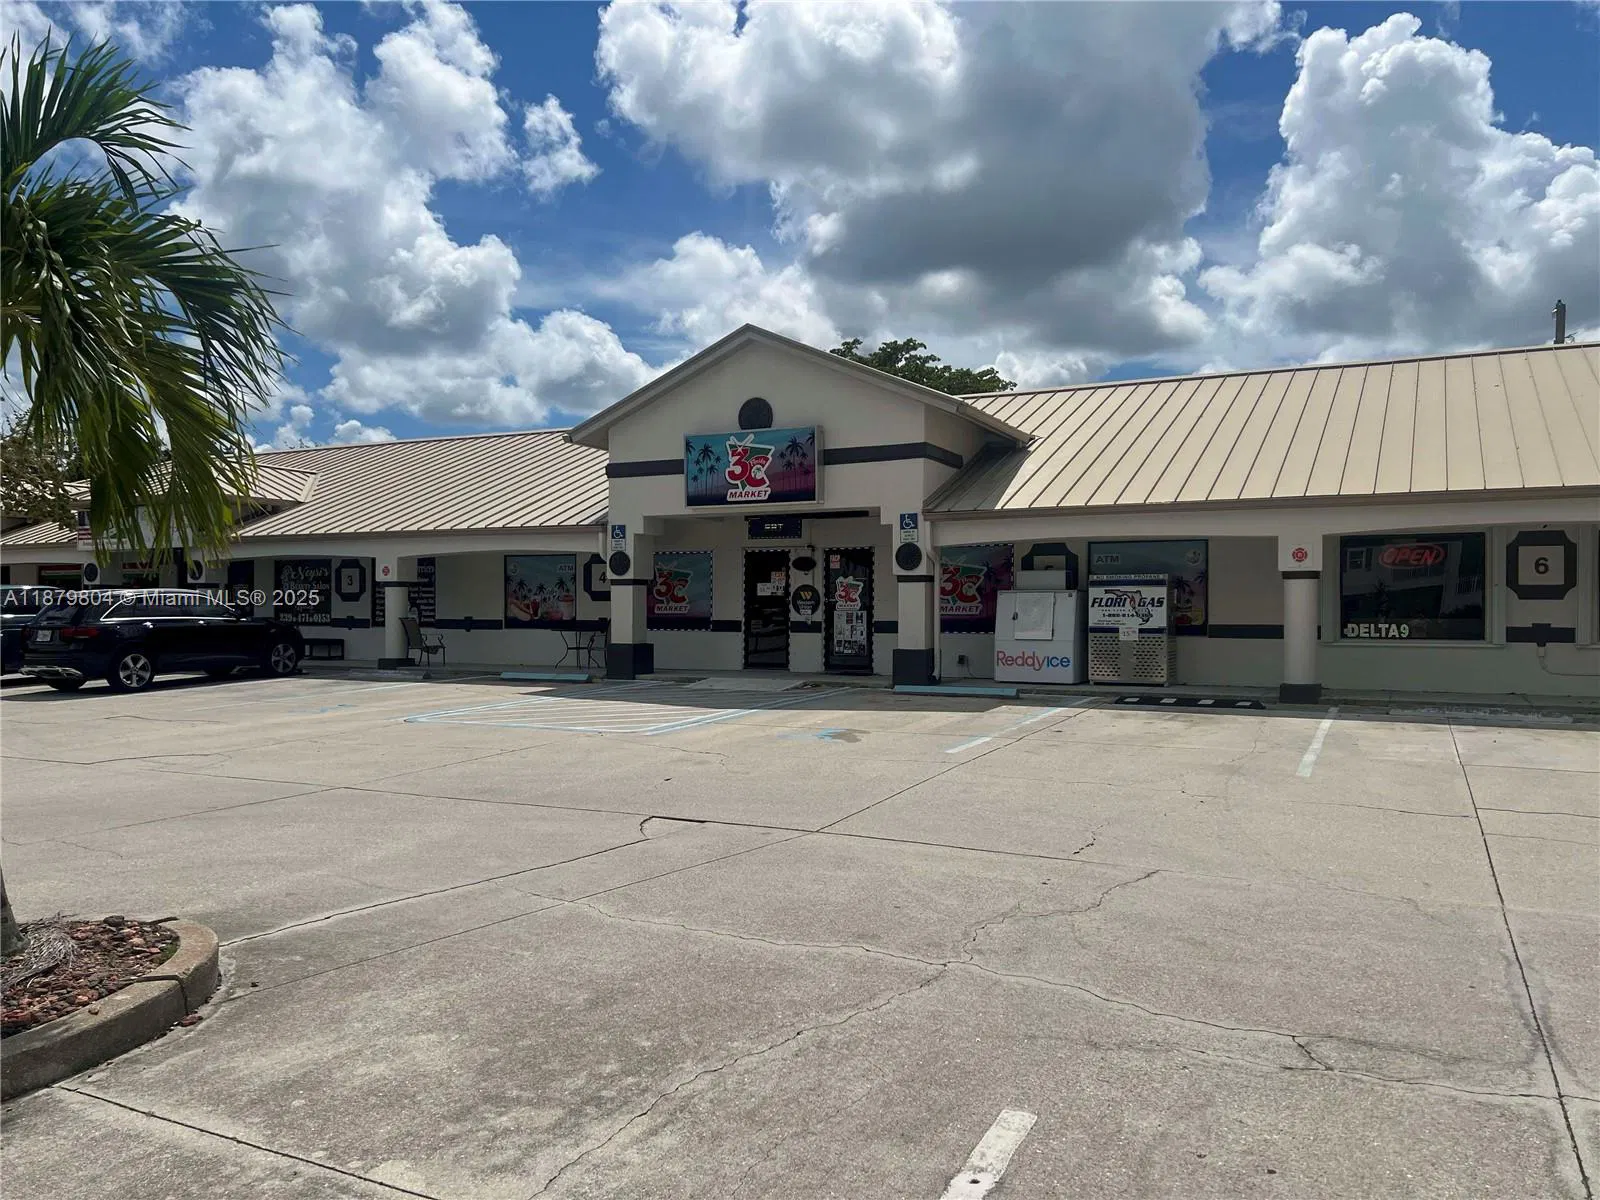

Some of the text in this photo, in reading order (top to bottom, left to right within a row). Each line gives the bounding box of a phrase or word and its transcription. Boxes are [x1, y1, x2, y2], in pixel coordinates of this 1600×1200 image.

[727, 447, 770, 487] 3C
[728, 489, 769, 499] MARKET
[1096, 555, 1119, 563] ATM
[1382, 548, 1437, 564] OPEN
[558, 564, 574, 572] ATM
[1534, 557, 1549, 575] 6
[347, 575, 353, 586] 3
[599, 572, 607, 584] 4
[1091, 597, 1165, 607] FLORI GAS
